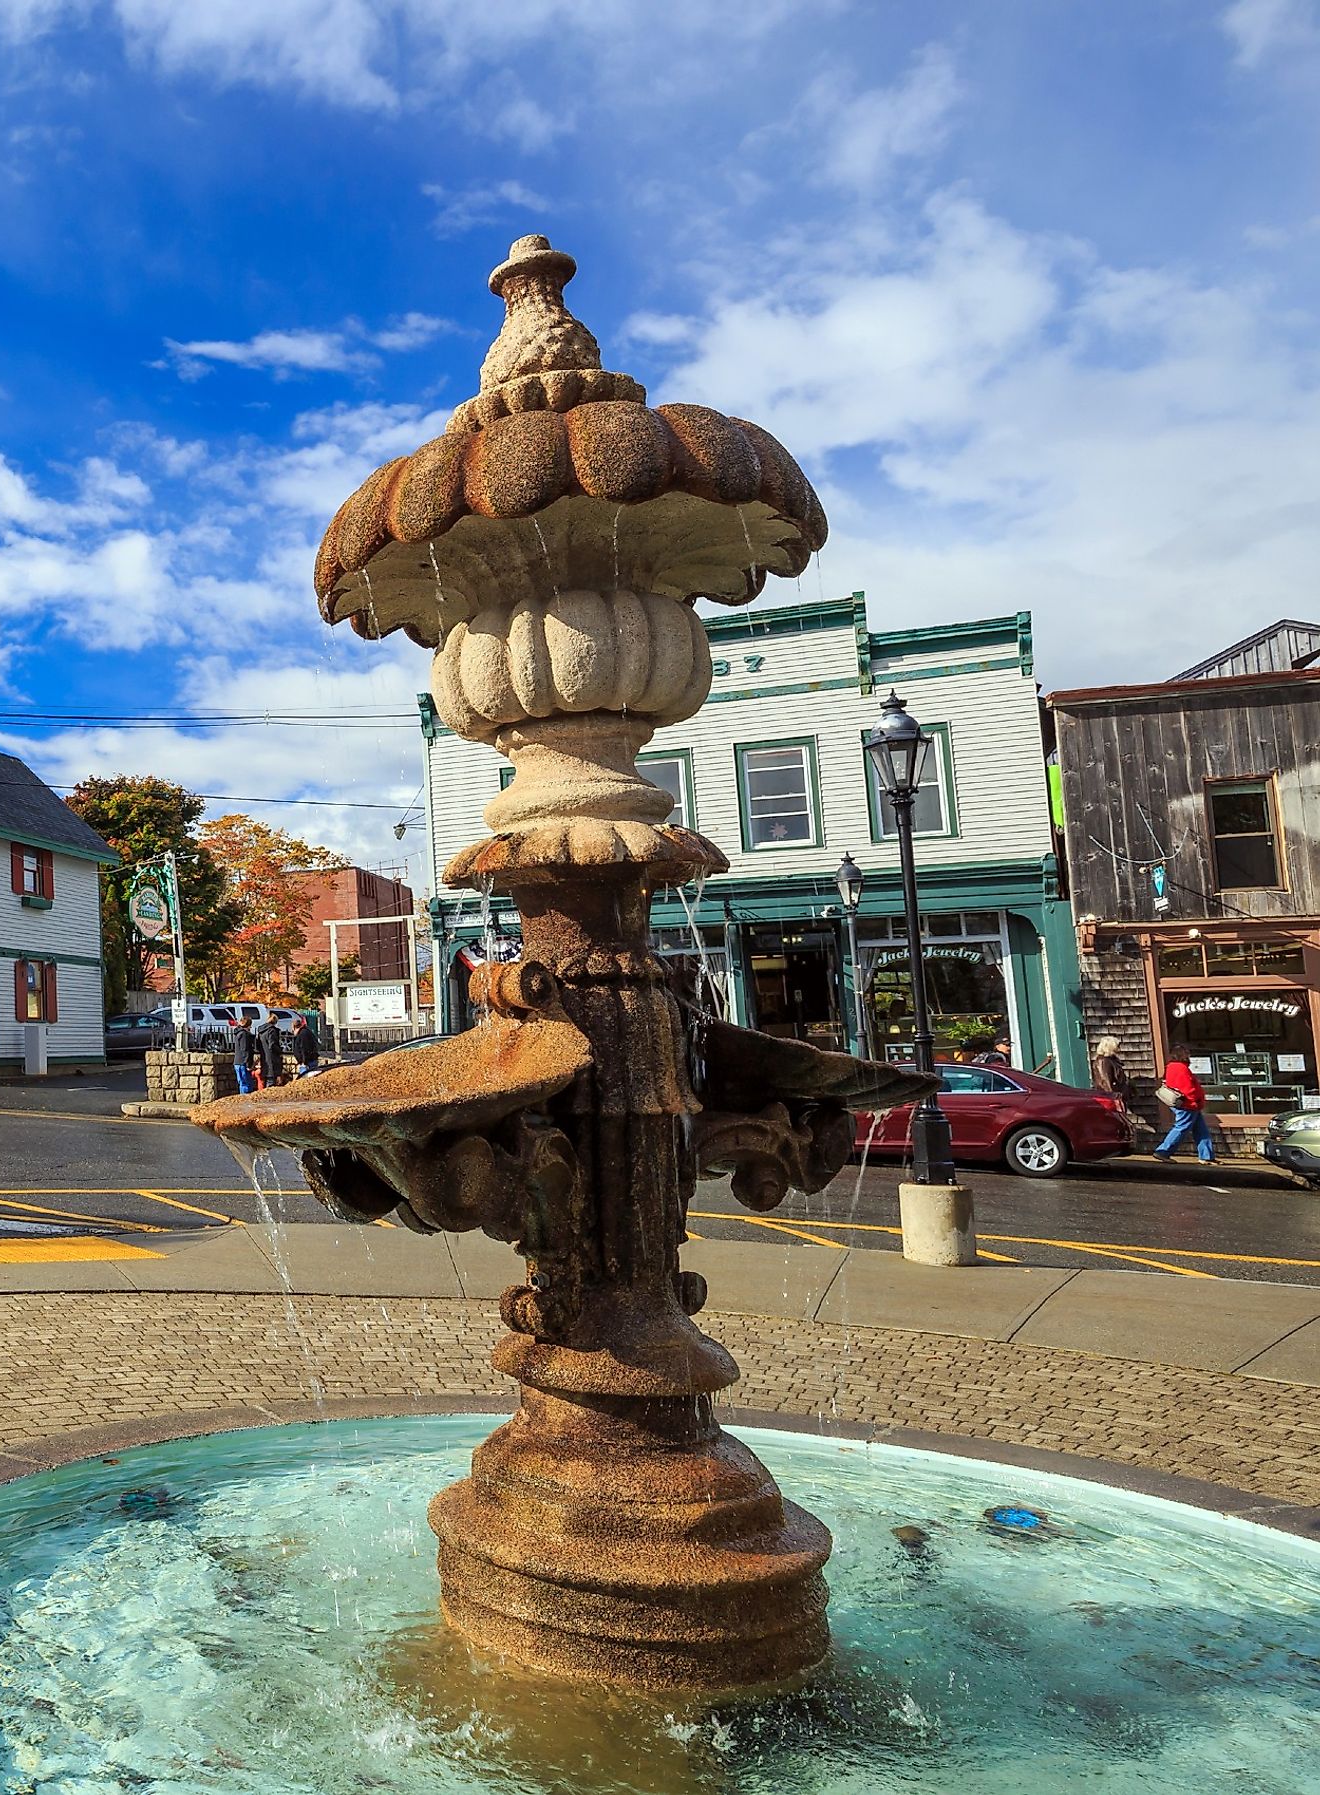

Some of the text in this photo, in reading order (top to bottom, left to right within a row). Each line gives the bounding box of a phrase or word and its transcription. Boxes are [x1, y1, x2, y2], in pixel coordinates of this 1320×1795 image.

[922, 946, 982, 965] Jewelry
[1173, 996, 1300, 1018] Jack's Jewelry
